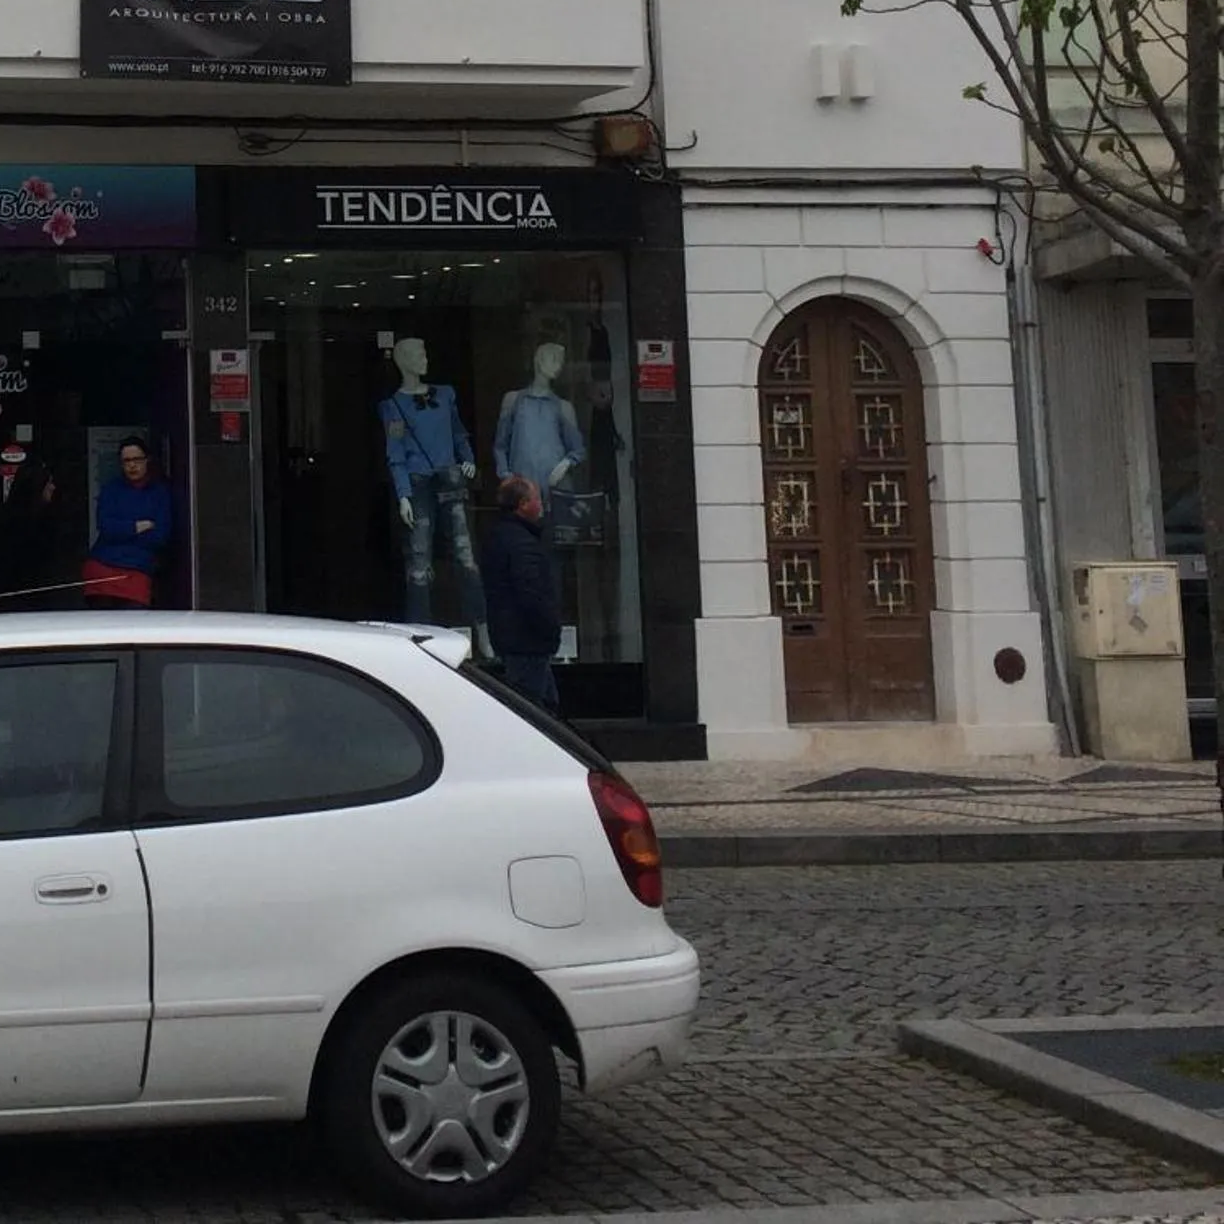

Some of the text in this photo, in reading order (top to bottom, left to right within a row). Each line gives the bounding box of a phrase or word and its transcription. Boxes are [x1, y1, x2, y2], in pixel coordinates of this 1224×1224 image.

[109, 7, 326, 24] ARQUITECTURA OBRA
[317, 184, 552, 223] TENDÊNCIA
[517, 218, 558, 229] MODA
[205, 296, 237, 313] 342
